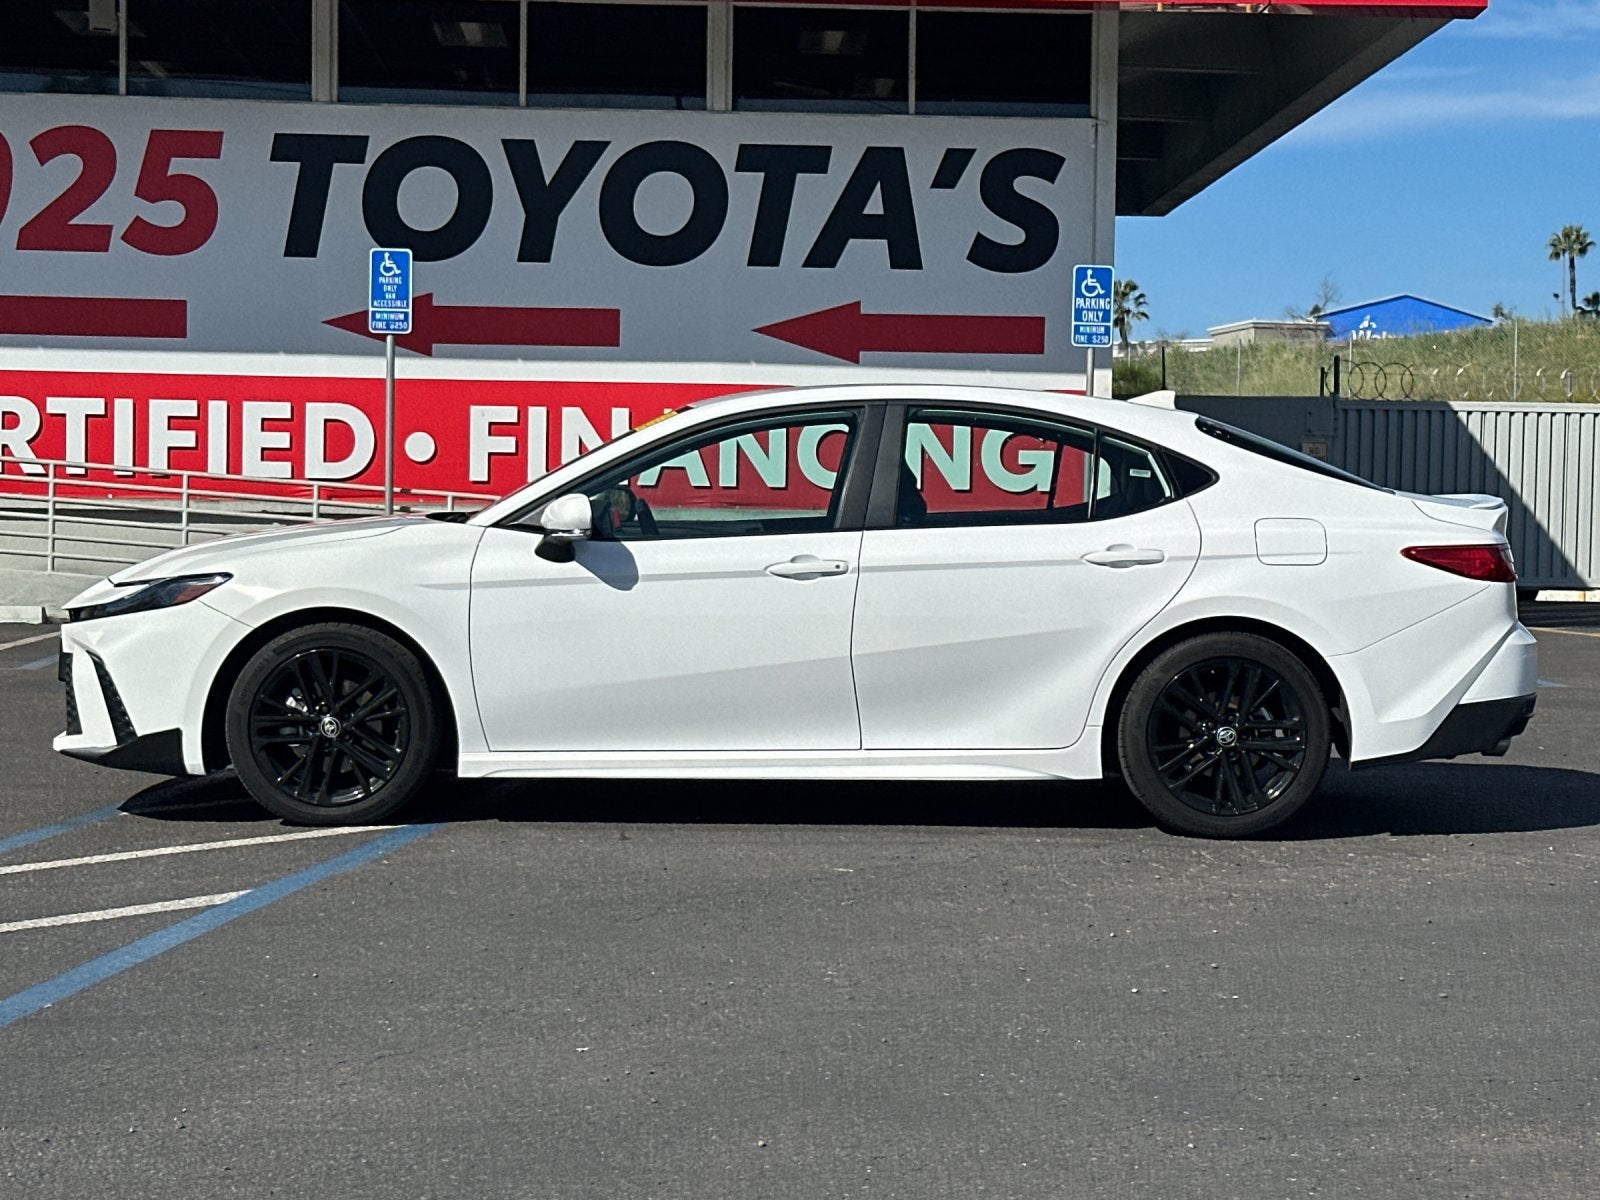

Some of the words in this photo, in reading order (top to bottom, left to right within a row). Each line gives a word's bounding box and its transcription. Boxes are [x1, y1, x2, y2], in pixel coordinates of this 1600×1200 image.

[0, 125, 224, 256] 25
[270, 133, 1066, 273] TOYOTA'S
[373, 300, 407, 308] ACCESSIBLE
[1076, 298, 1110, 310] PARKING
[1082, 310, 1104, 322] ONLY
[372, 320, 386, 328] FINE
[1080, 326, 1105, 334] MINIMUM
[1075, 334, 1088, 343] FINE
[1092, 335, 1109, 344] $250
